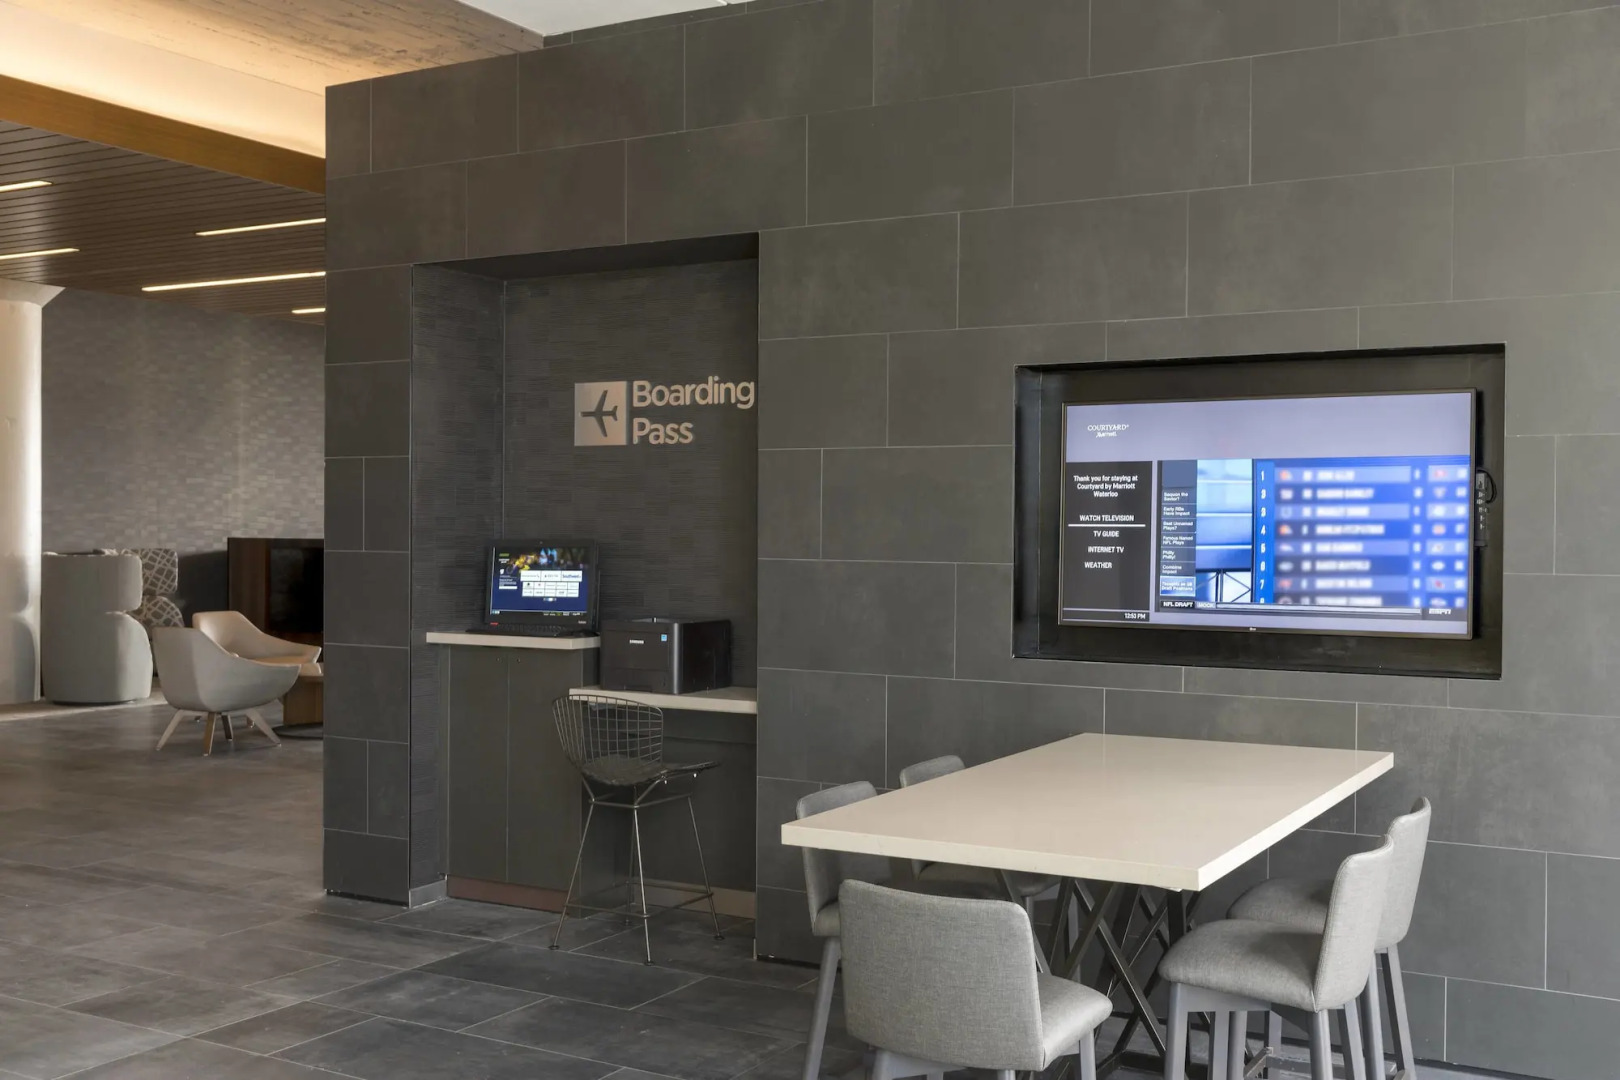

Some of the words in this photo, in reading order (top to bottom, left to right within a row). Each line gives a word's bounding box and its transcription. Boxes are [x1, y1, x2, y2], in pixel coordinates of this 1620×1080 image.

[632, 375, 755, 409] Boarding
[632, 417, 694, 444] Pass
[1261, 471, 1265, 481] 1
[1261, 525, 1266, 535] 4
[1260, 543, 1266, 553] 5
[1260, 579, 1265, 590] 7
